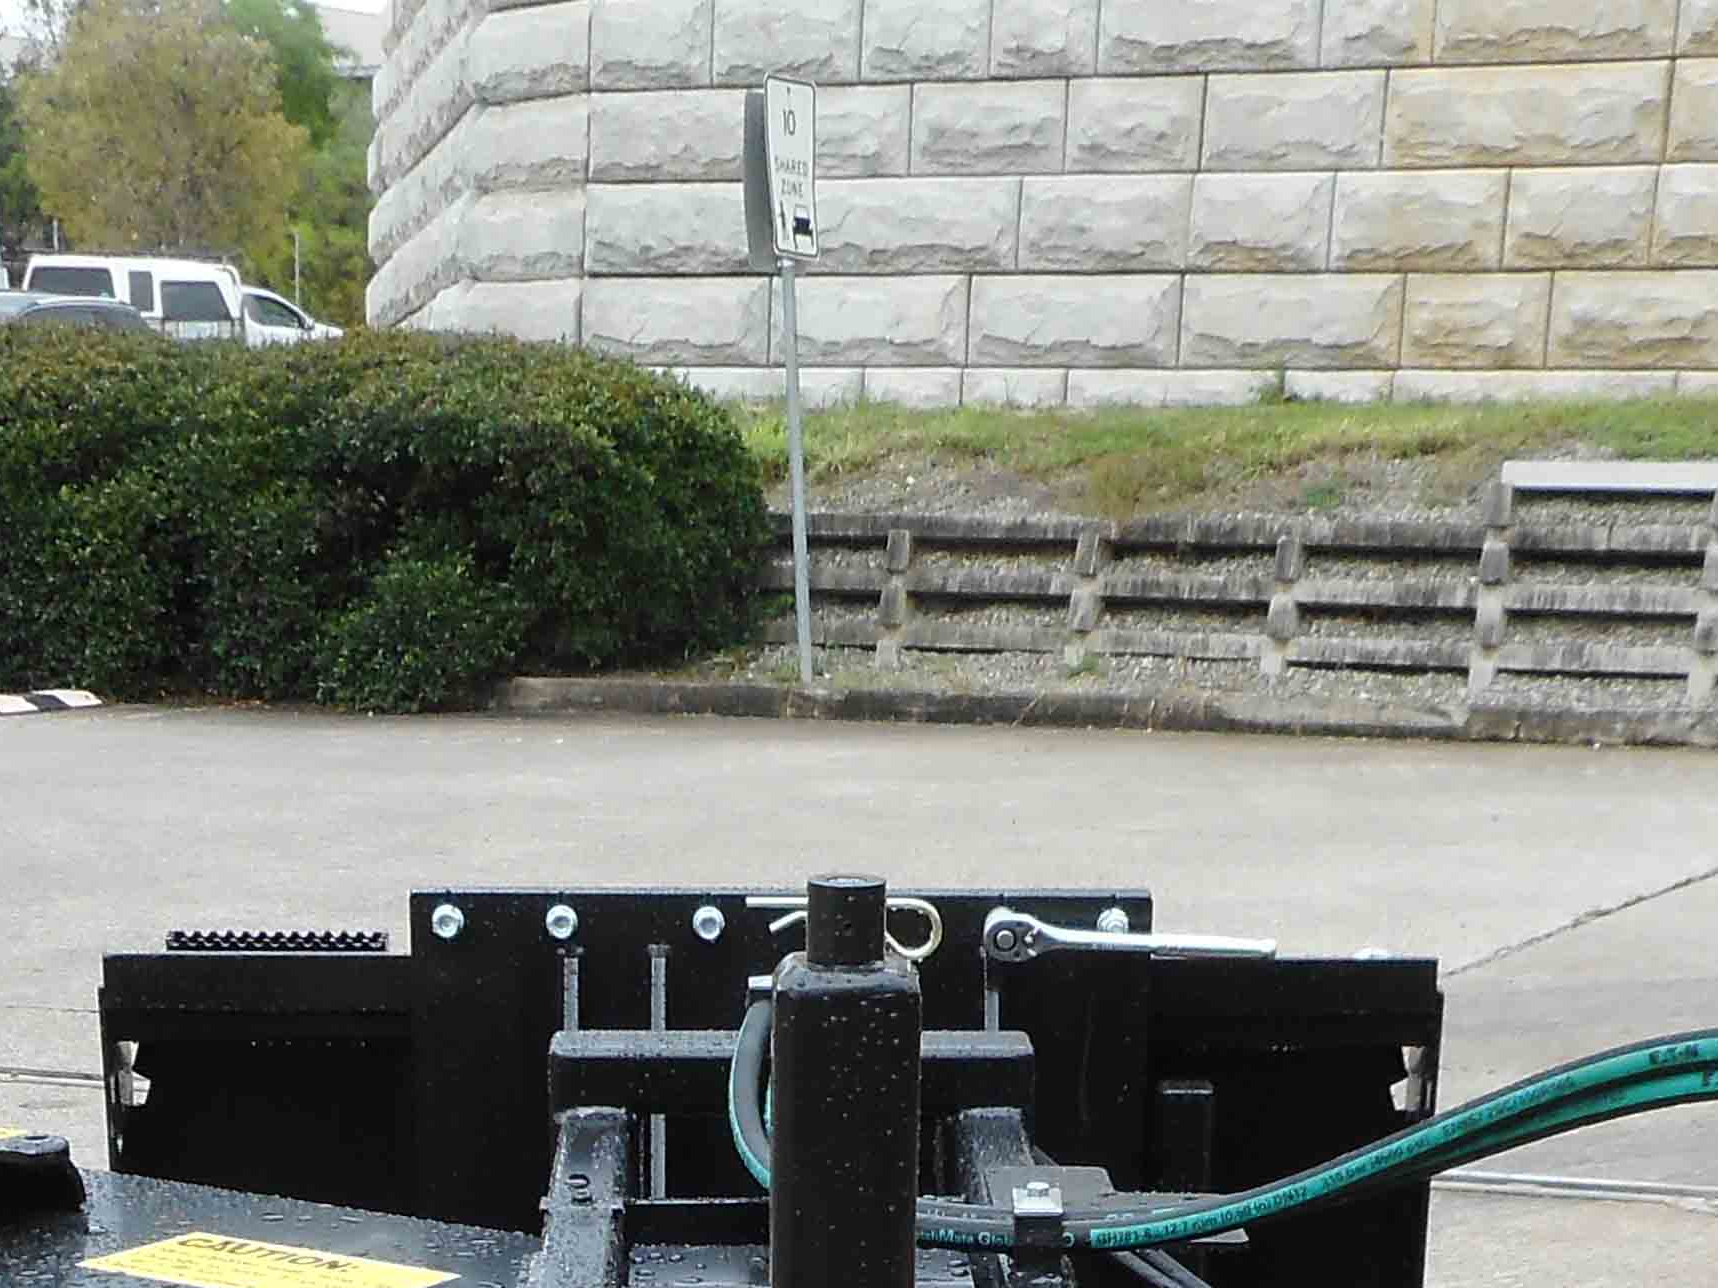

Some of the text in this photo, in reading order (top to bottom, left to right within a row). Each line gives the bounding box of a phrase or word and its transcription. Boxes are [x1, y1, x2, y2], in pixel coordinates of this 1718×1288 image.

[782, 108, 796, 136] 10
[773, 155, 810, 177] SHARED
[780, 178, 804, 199] ZONE
